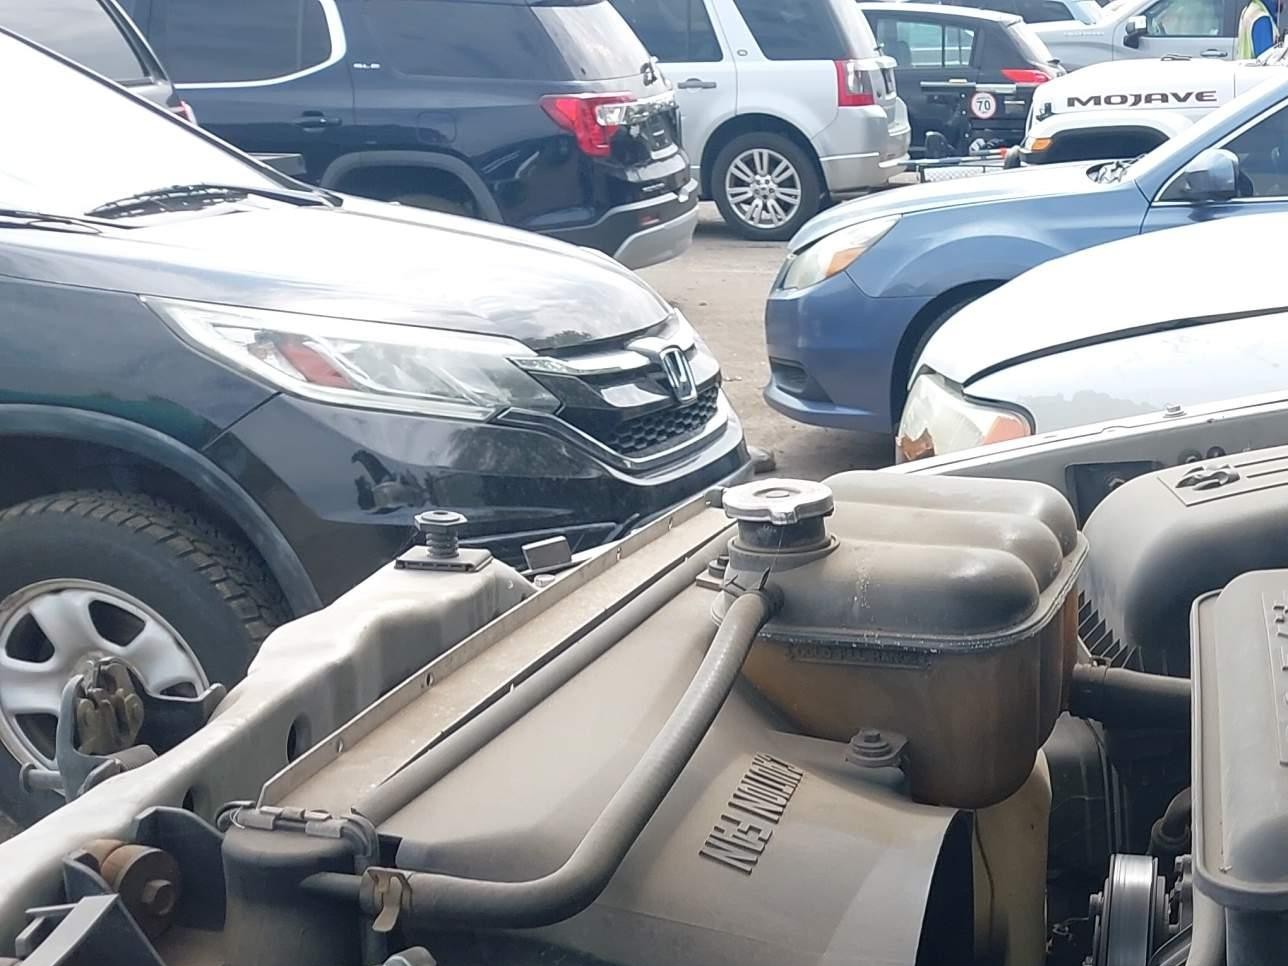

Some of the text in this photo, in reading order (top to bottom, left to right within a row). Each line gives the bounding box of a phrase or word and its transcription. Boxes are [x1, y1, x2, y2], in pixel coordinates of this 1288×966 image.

[976, 100, 991, 111] 70
[1066, 90, 1218, 108] MOJAVE
[698, 752, 804, 876] CAUTION FAN
